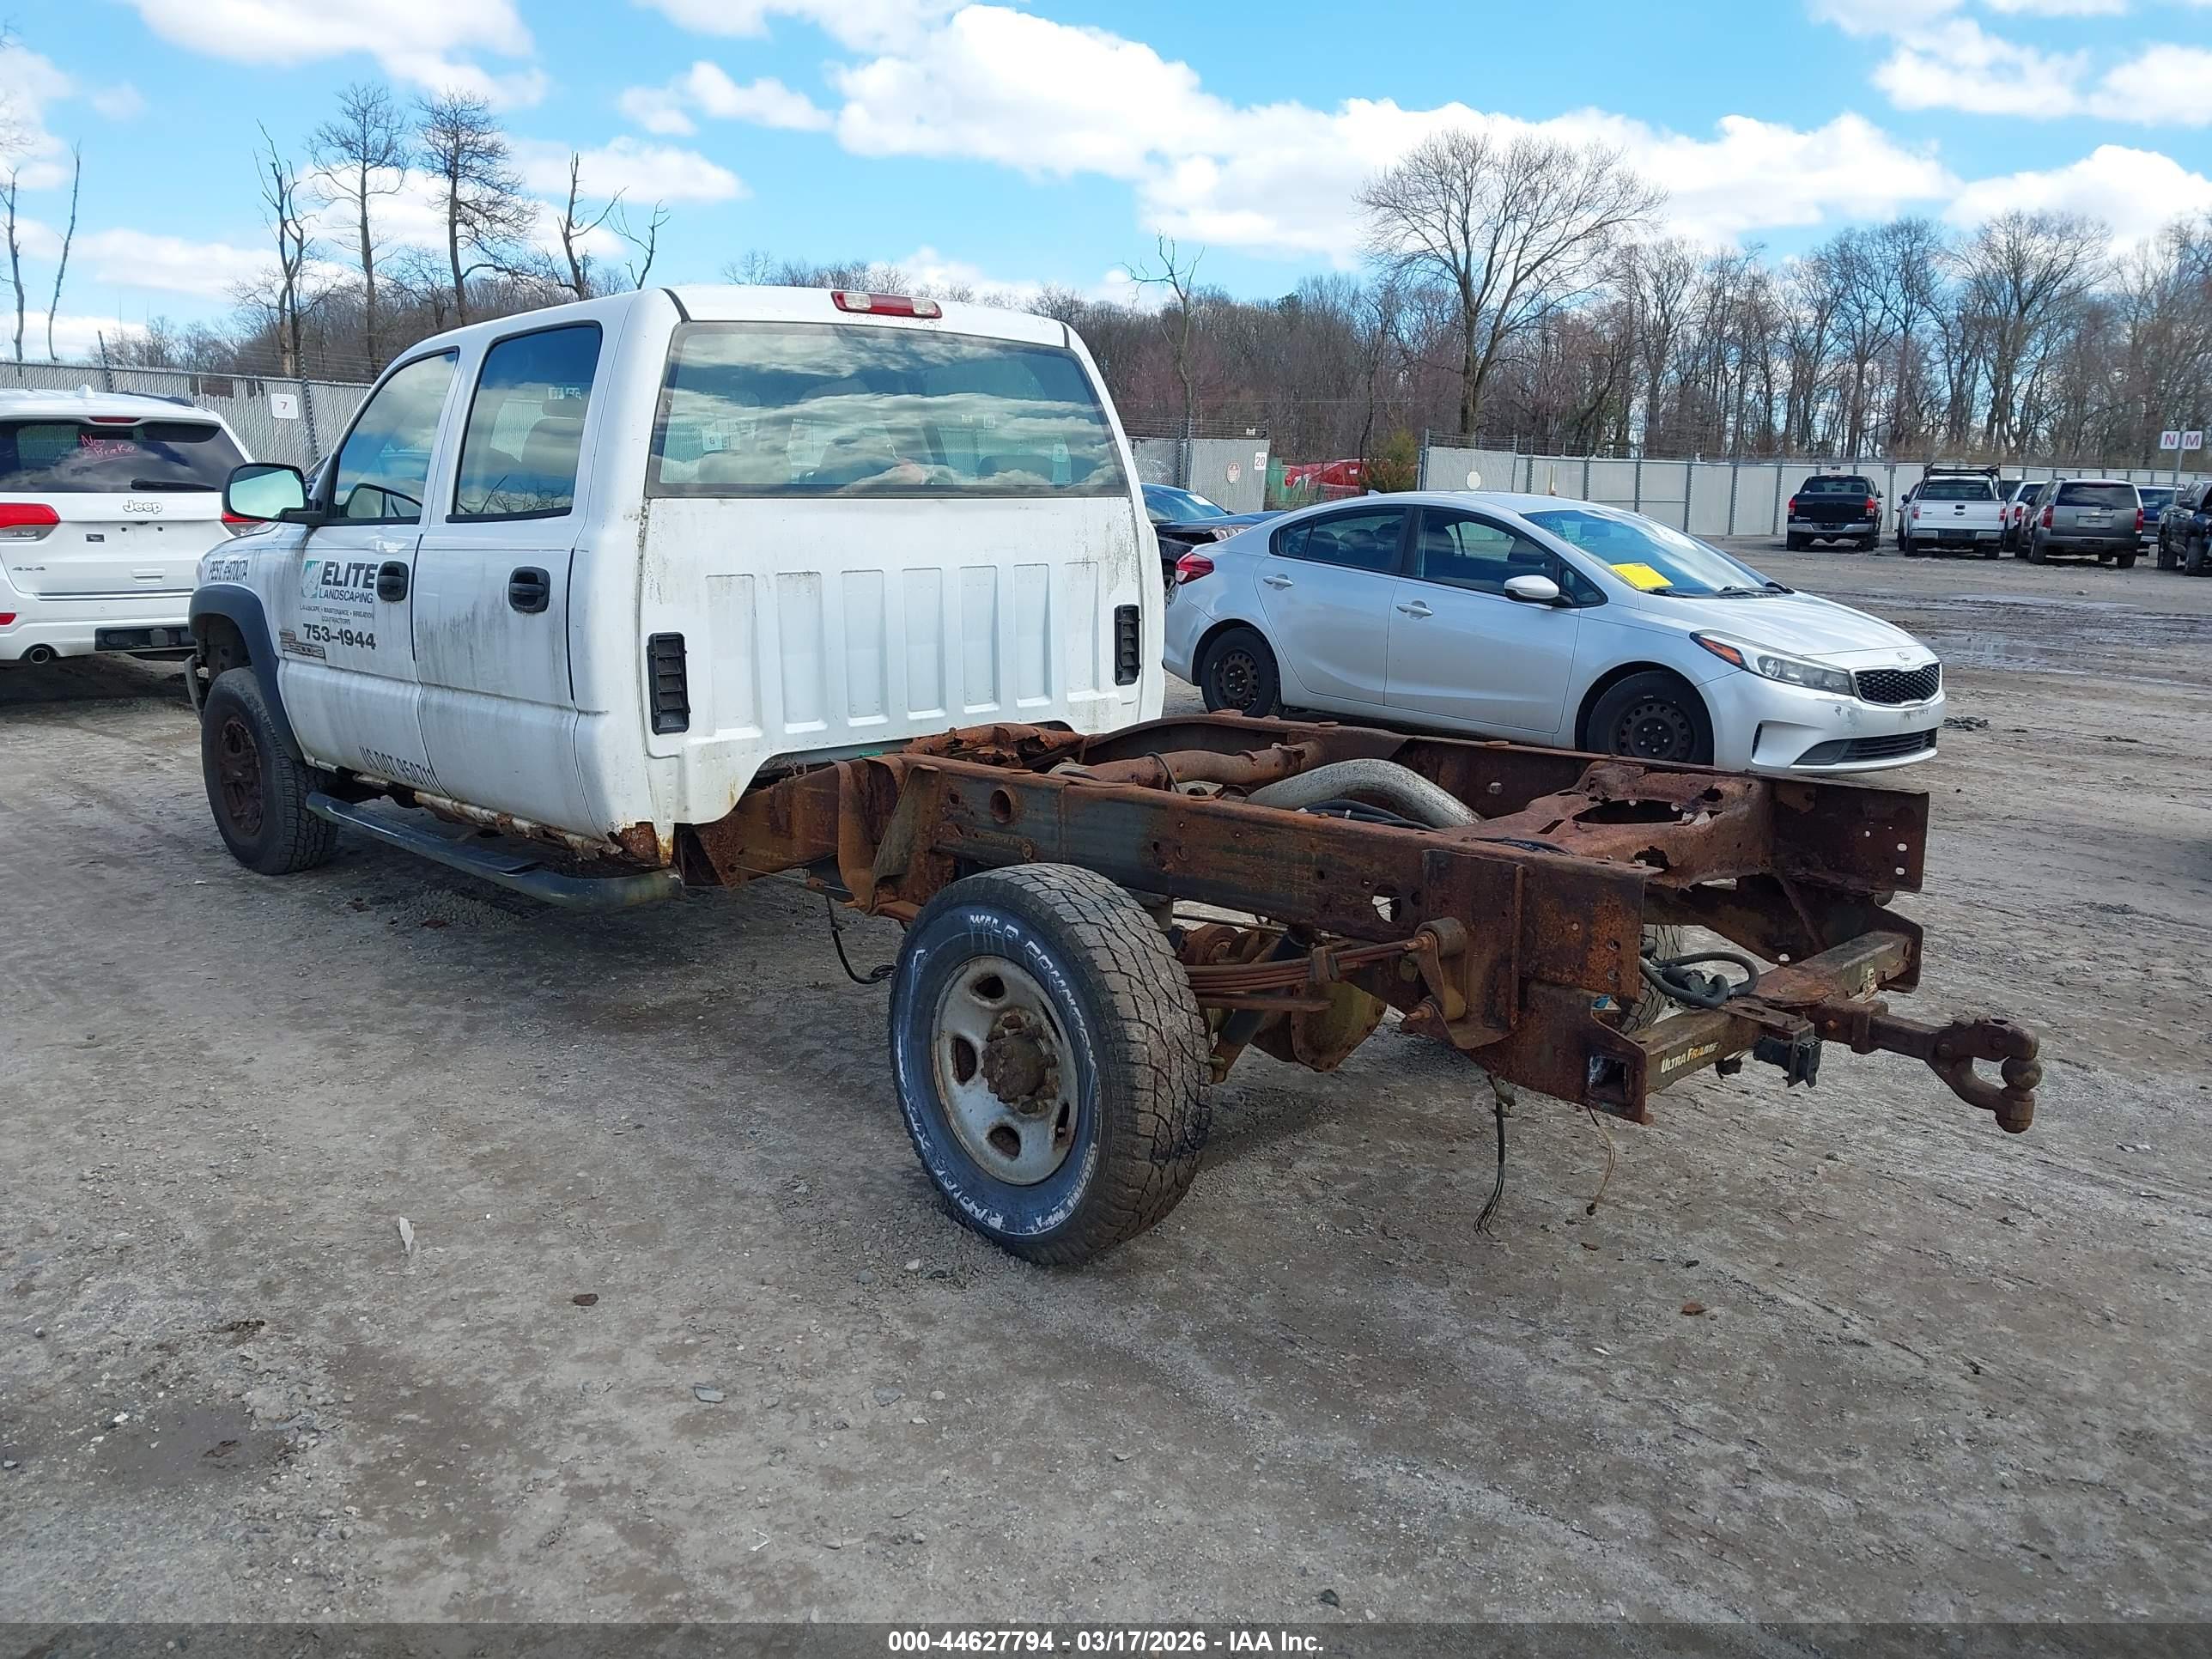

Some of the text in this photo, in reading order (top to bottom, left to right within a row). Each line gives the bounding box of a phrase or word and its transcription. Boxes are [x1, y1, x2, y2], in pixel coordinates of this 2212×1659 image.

[280, 400, 288, 410] 7
[2164, 434, 2176, 446] N
[2185, 434, 2199, 447] M
[1255, 456, 1266, 466] 20
[123, 500, 162, 514] Jeep
[321, 561, 379, 589] ELITE
[319, 587, 374, 604] LANDSCAPING
[303, 623, 376, 650] 753-1944
[374, 750, 401, 778] DOT
